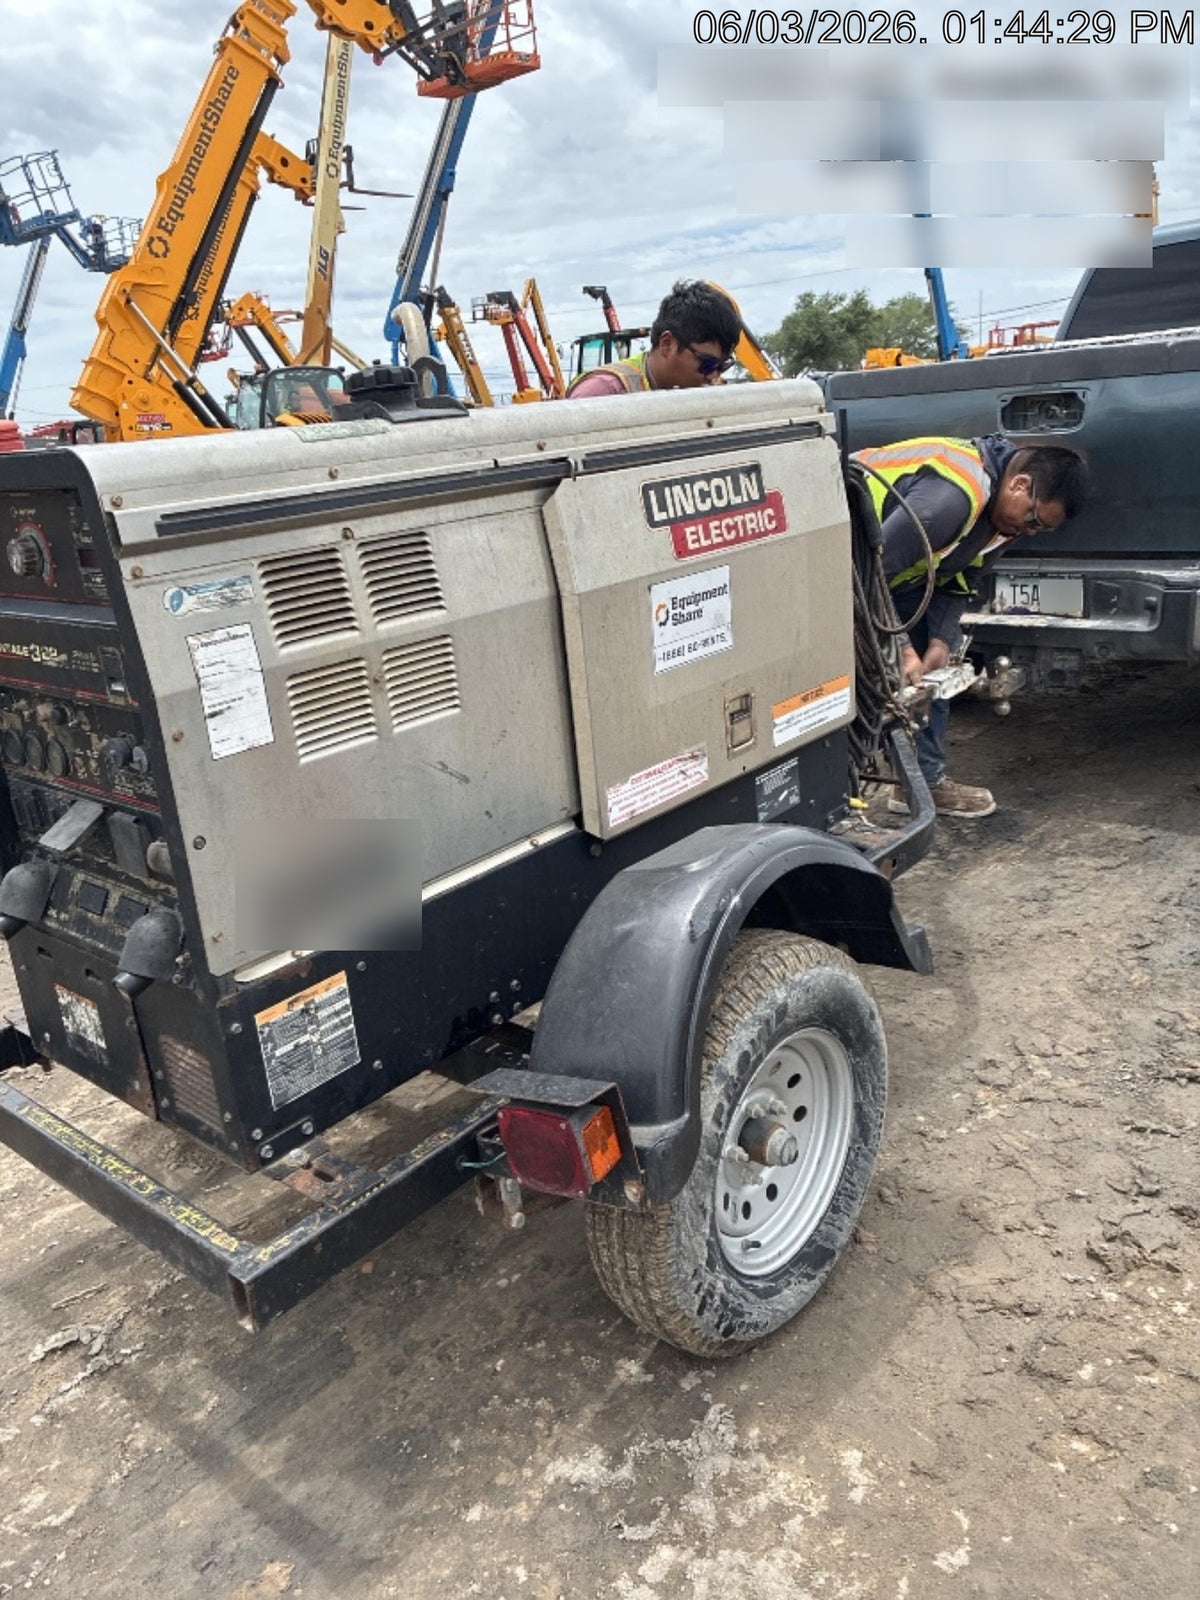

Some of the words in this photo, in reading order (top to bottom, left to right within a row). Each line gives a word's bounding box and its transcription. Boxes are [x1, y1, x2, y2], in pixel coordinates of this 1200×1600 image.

[157, 65, 240, 236] EquipmentShare
[316, 245, 331, 281] JLG
[648, 472, 761, 522] LINCOLN
[684, 508, 778, 550] ELECTRIC
[671, 583, 728, 611] Equipment
[671, 608, 704, 627] Share
